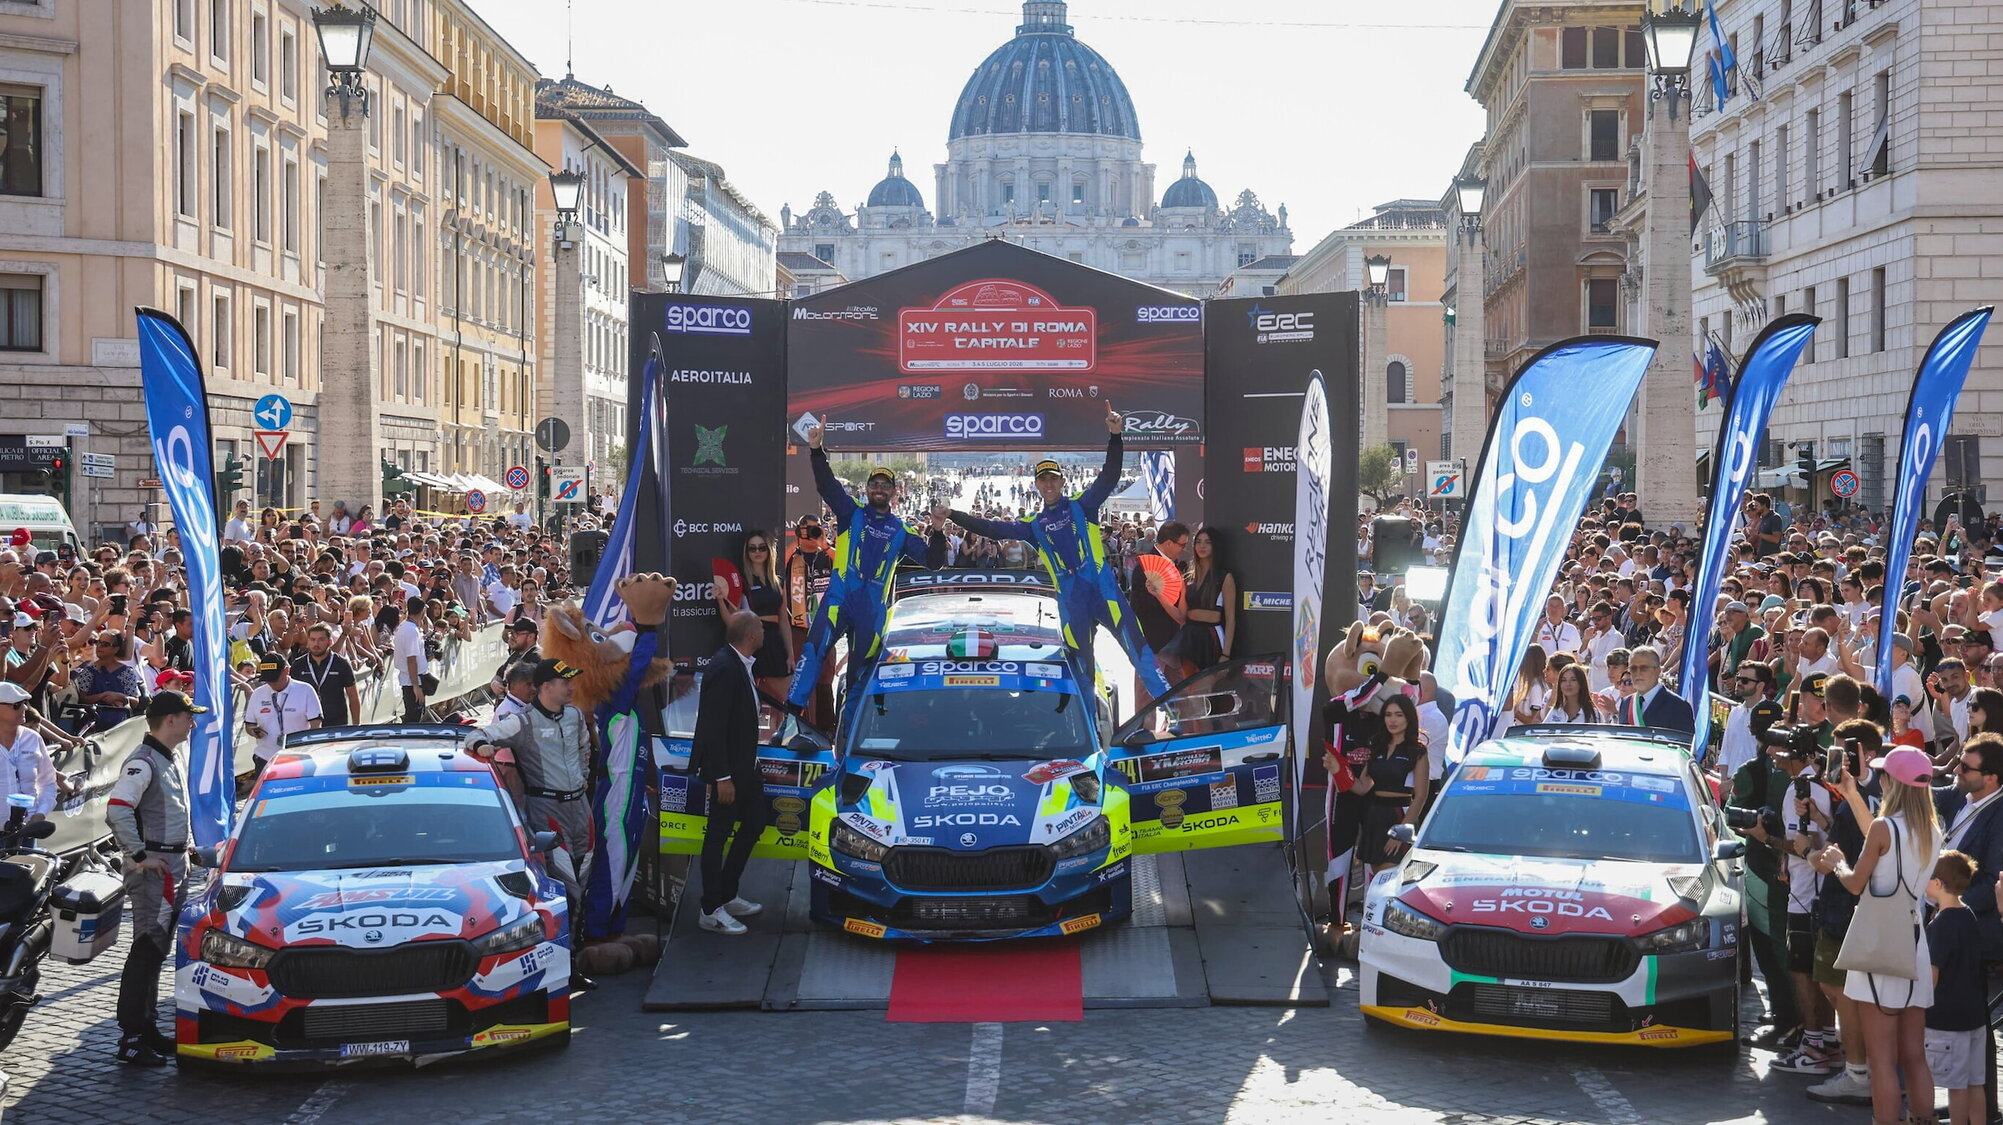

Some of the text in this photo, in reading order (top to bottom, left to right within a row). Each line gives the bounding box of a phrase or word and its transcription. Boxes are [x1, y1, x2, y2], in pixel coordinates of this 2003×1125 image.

[667, 306, 751, 333] sparco
[793, 307, 879, 320] Motorsport
[1137, 307, 1200, 322] sparco
[906, 322, 1088, 333] XIV RALLY DI ROMA
[1257, 312, 1314, 331] ERC
[954, 337, 1040, 348] CAPITALE
[671, 370, 753, 384] AEROITALIA
[1049, 388, 1084, 398] ROMA
[824, 422, 876, 432] SPORT
[946, 415, 1042, 439] sparco
[1124, 414, 1190, 435] Rally
[1264, 462, 1297, 472] MOTOR
[689, 522, 742, 533] BCC ROMA
[1270, 534, 1289, 542] driving
[672, 582, 716, 601] sara
[672, 606, 717, 617] ti assicura
[922, 660, 1019, 676] sparco
[948, 677, 995, 685] PIRELLI
[804, 763, 823, 788] 24
[1511, 768, 1624, 787] sparco
[1163, 778, 1200, 789] Championship
[763, 786, 800, 796] Championship
[930, 785, 1010, 797] PEJO
[1212, 800, 1236, 808] ASFALTI
[660, 821, 687, 830] ORCE
[1500, 888, 1585, 902] MOTUL
[844, 920, 884, 938] PIRELLI
[1062, 914, 1101, 933] PIRELLI
[1404, 1010, 1441, 1027] PIRELLI
[488, 1028, 532, 1042] PIRELLI
[1638, 1029, 1679, 1041] PIRELLI
[214, 1046, 260, 1059] PIRELLI
